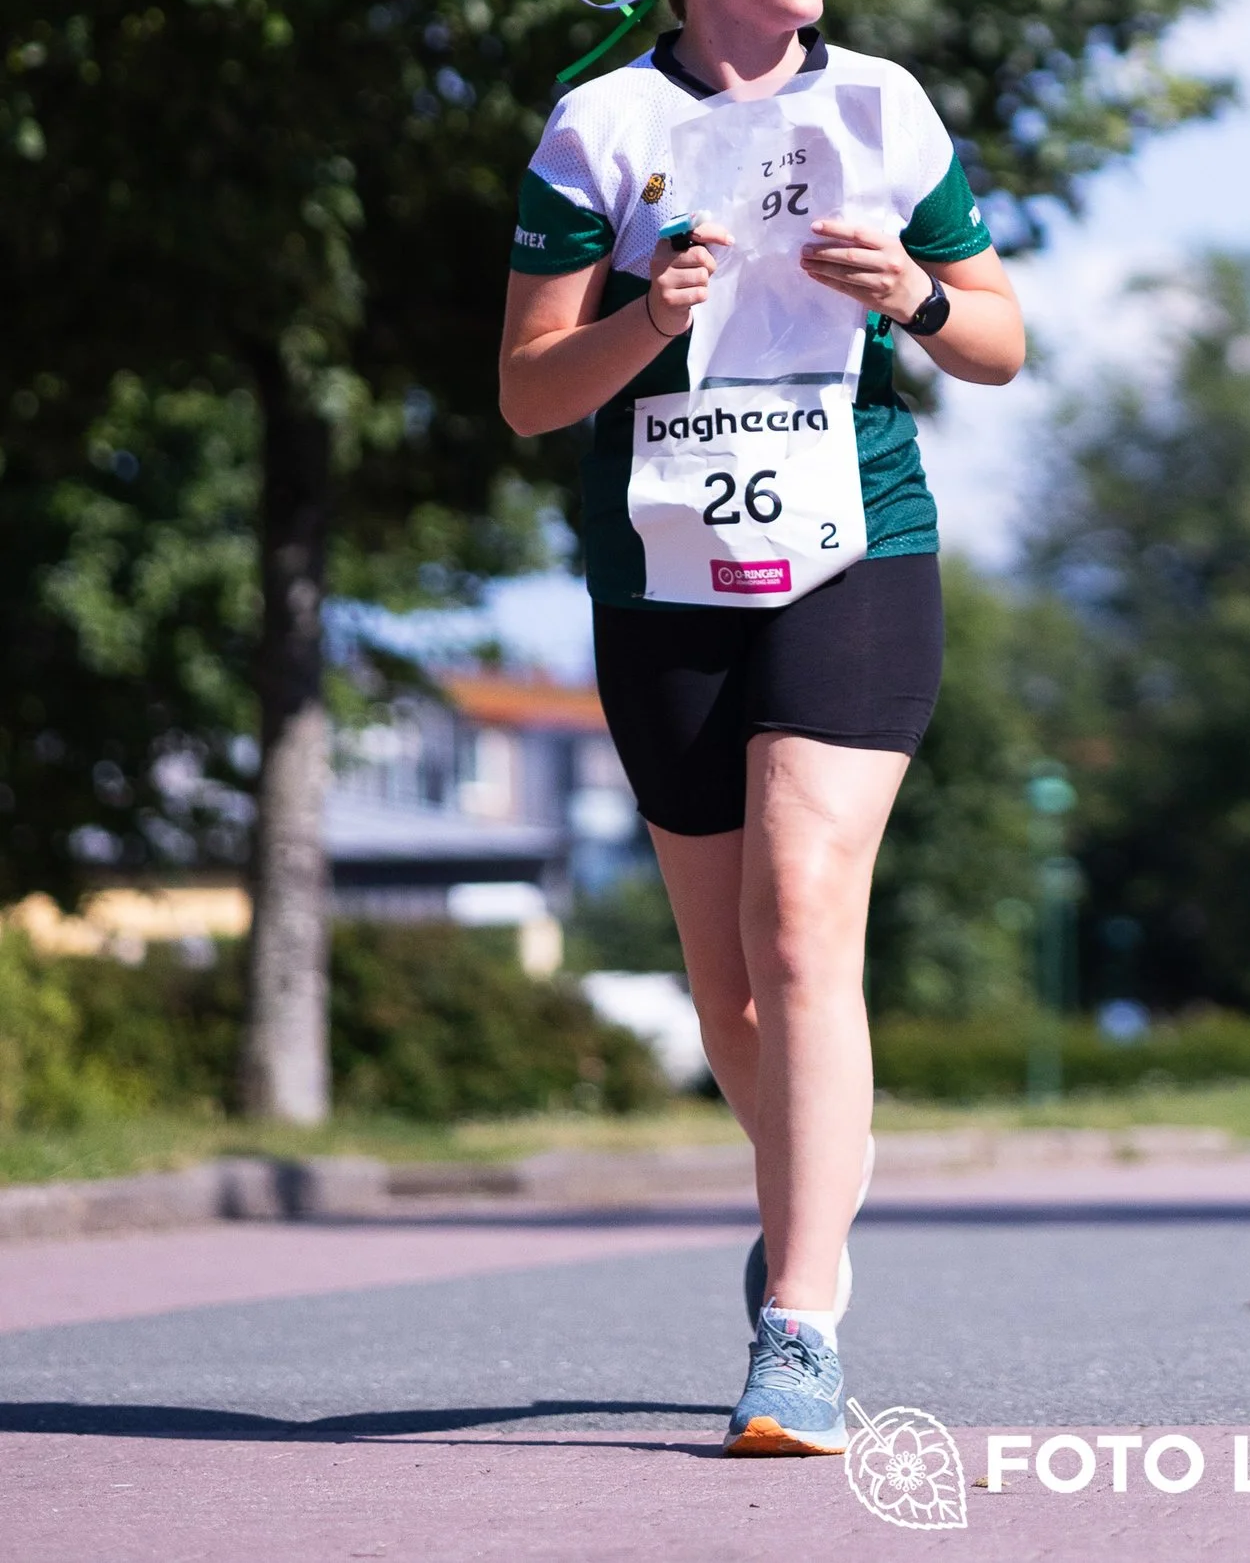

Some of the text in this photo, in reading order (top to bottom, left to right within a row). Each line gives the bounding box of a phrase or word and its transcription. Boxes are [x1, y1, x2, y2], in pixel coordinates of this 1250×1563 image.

[761, 149, 807, 178] Str 2
[762, 183, 809, 221] 26
[647, 407, 829, 443] bagheera
[703, 469, 783, 526] 26
[820, 522, 840, 550] 2
[734, 568, 784, 580] O-RINGEN
